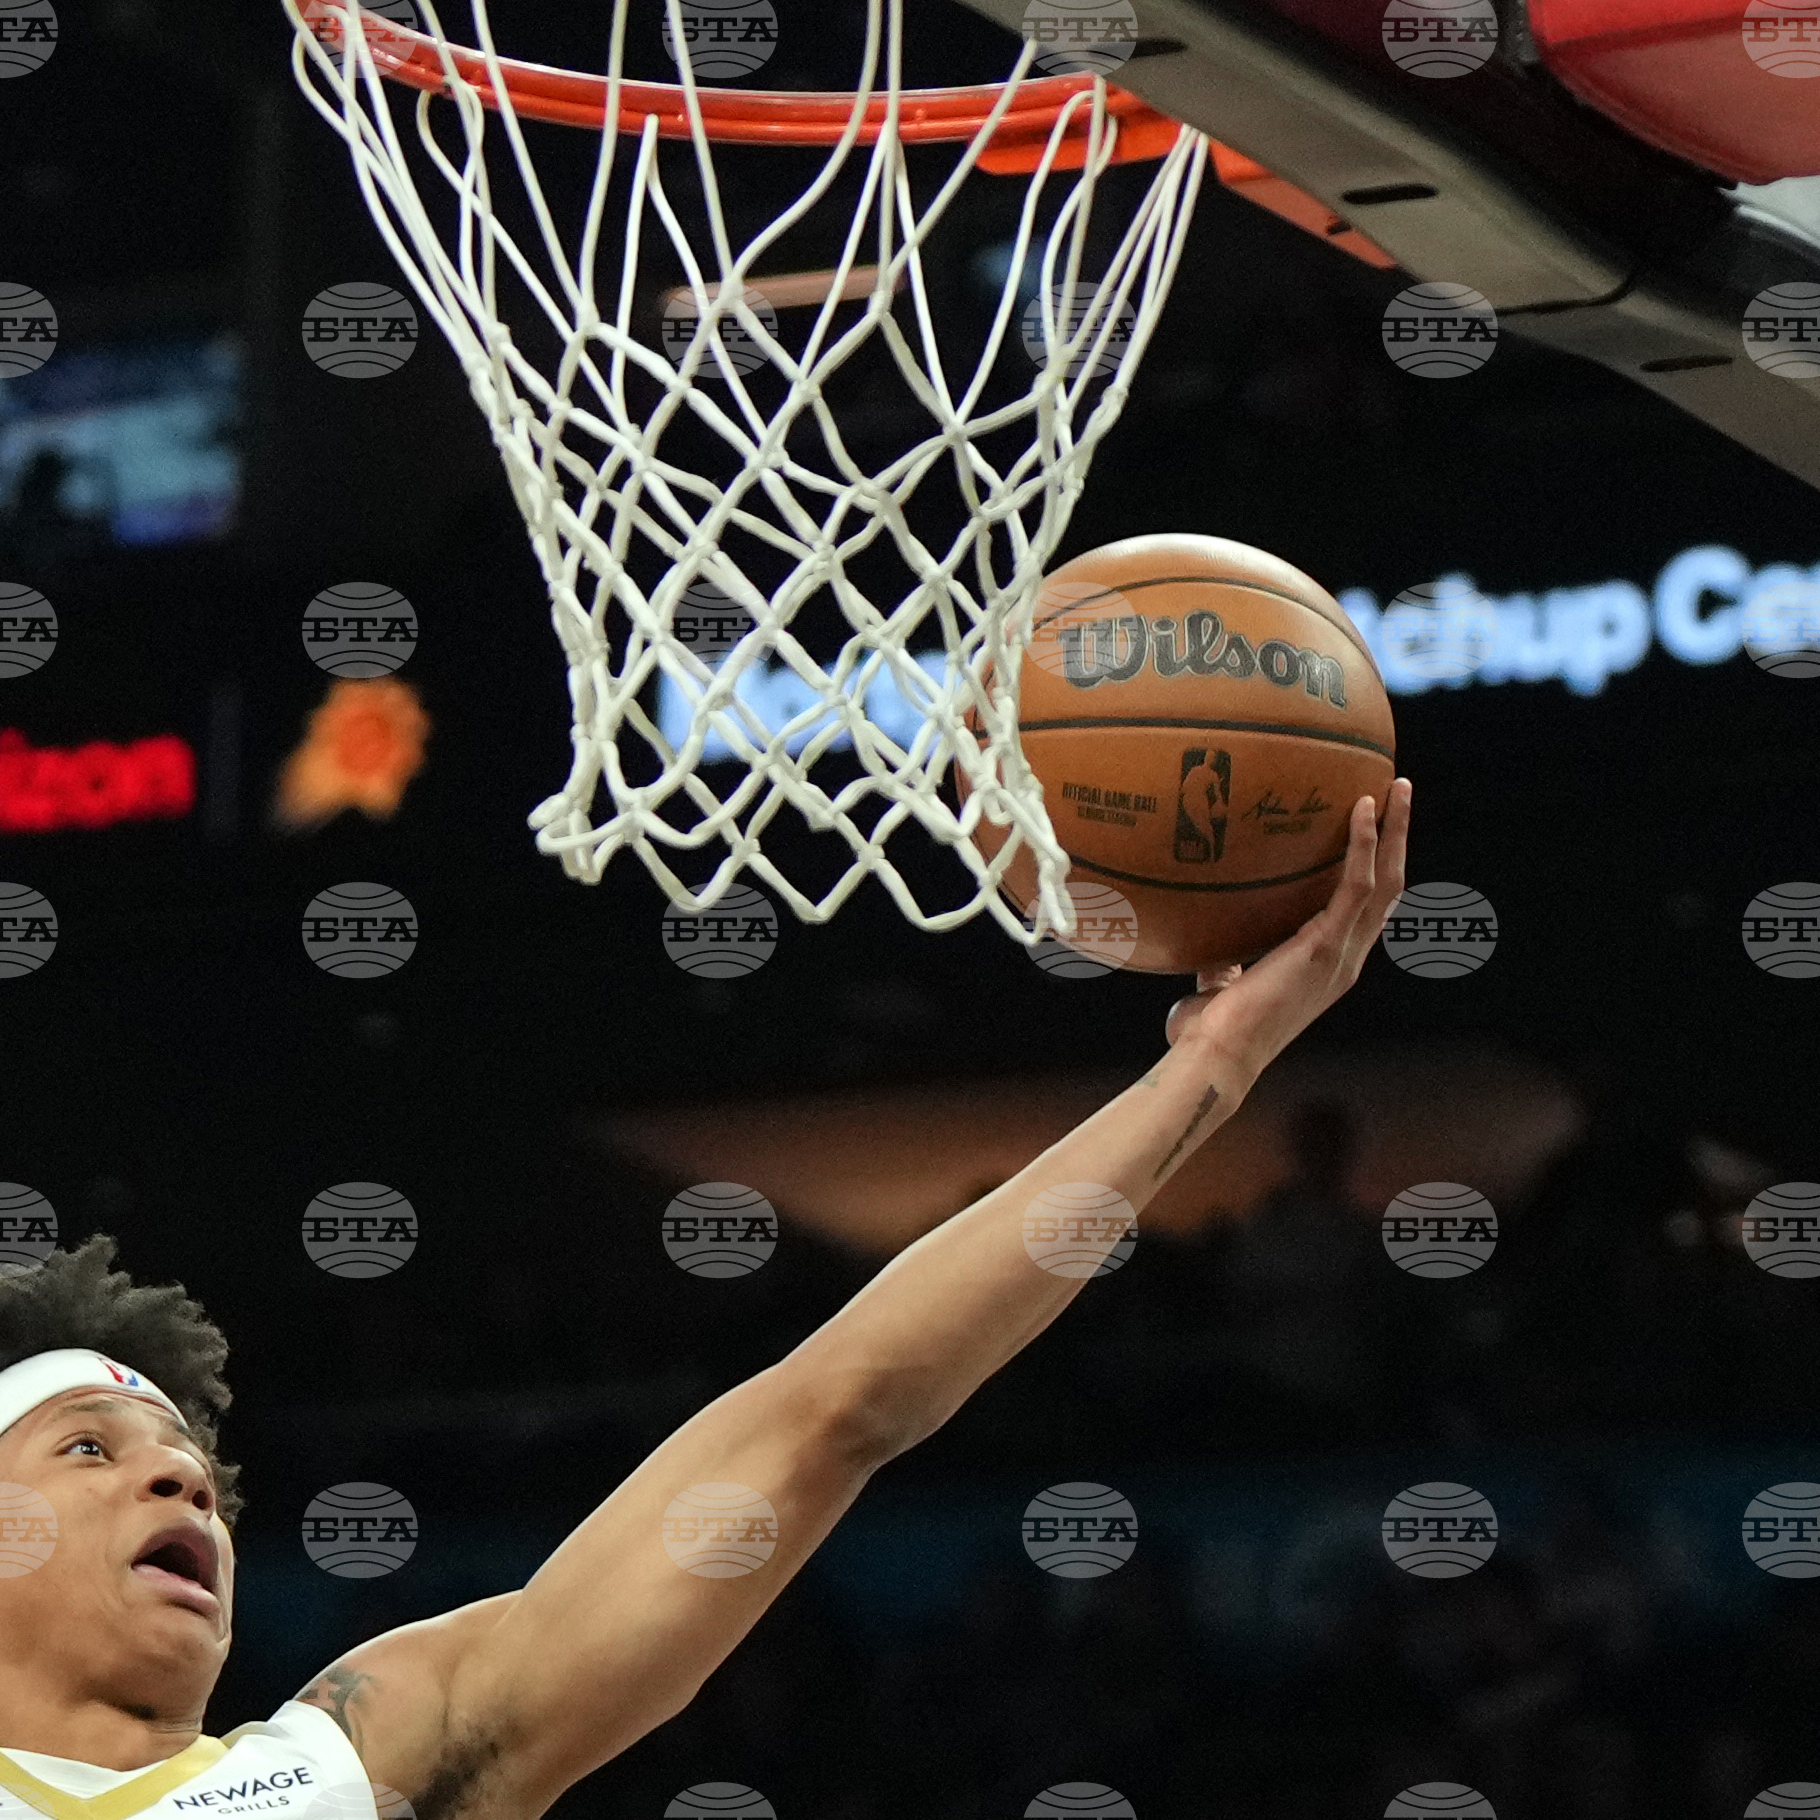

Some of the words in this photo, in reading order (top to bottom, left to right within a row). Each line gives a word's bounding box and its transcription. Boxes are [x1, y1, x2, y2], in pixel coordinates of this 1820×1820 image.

[1654, 543, 1820, 665] Ce
[1058, 609, 1347, 709] Wilson
[172, 1766, 314, 1811] NEWAGE
[217, 1795, 291, 1815] GRILLS
